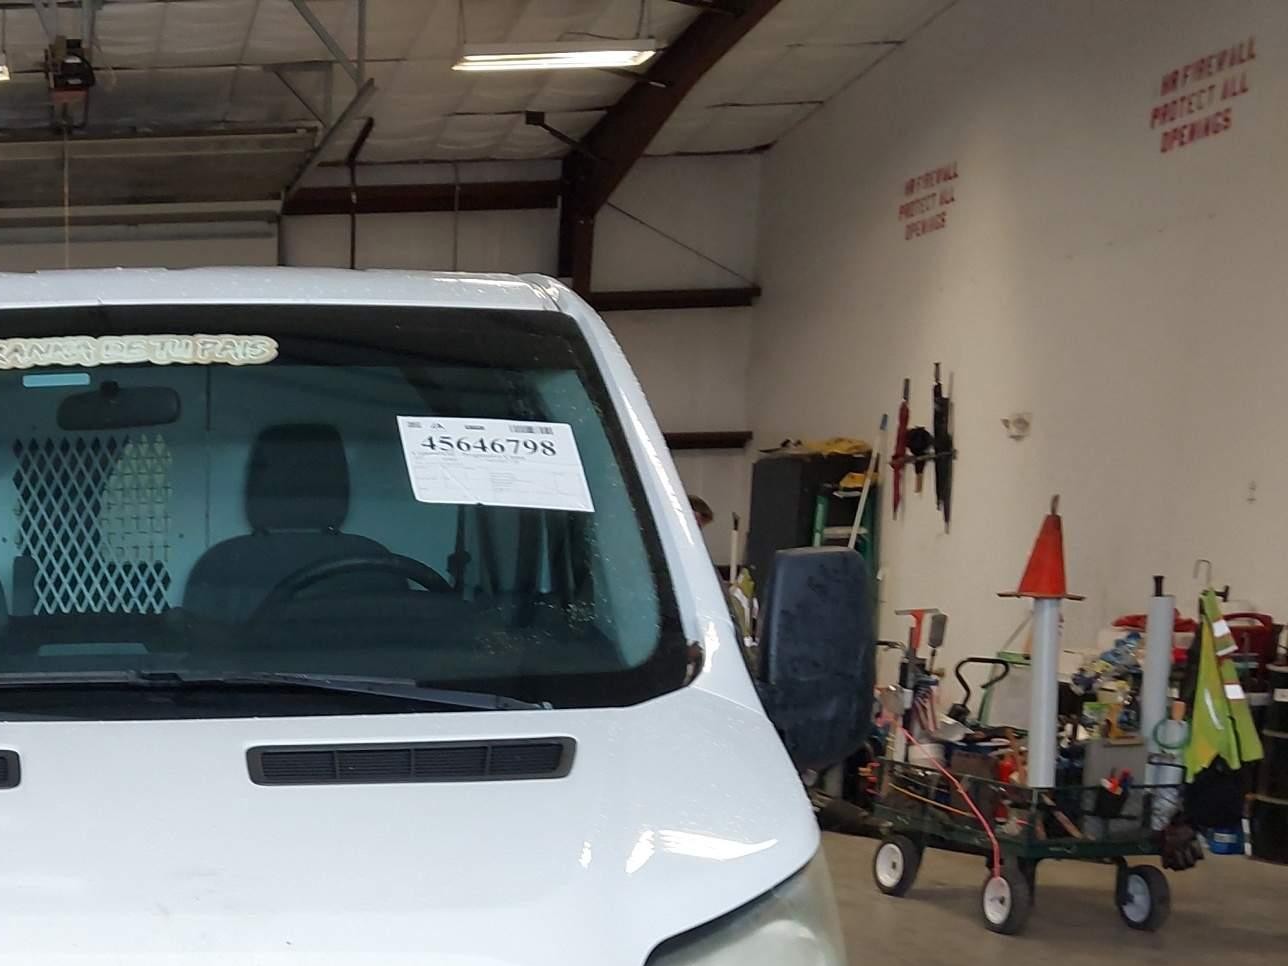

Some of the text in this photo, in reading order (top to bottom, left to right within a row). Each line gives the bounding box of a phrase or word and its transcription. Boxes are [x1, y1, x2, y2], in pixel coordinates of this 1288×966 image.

[1150, 72, 1248, 128] PROTECT ALL
[1160, 108, 1231, 154] OPENINGS
[149, 339, 193, 361] TU
[196, 337, 270, 363] PAIS
[421, 435, 557, 456] 45646798
